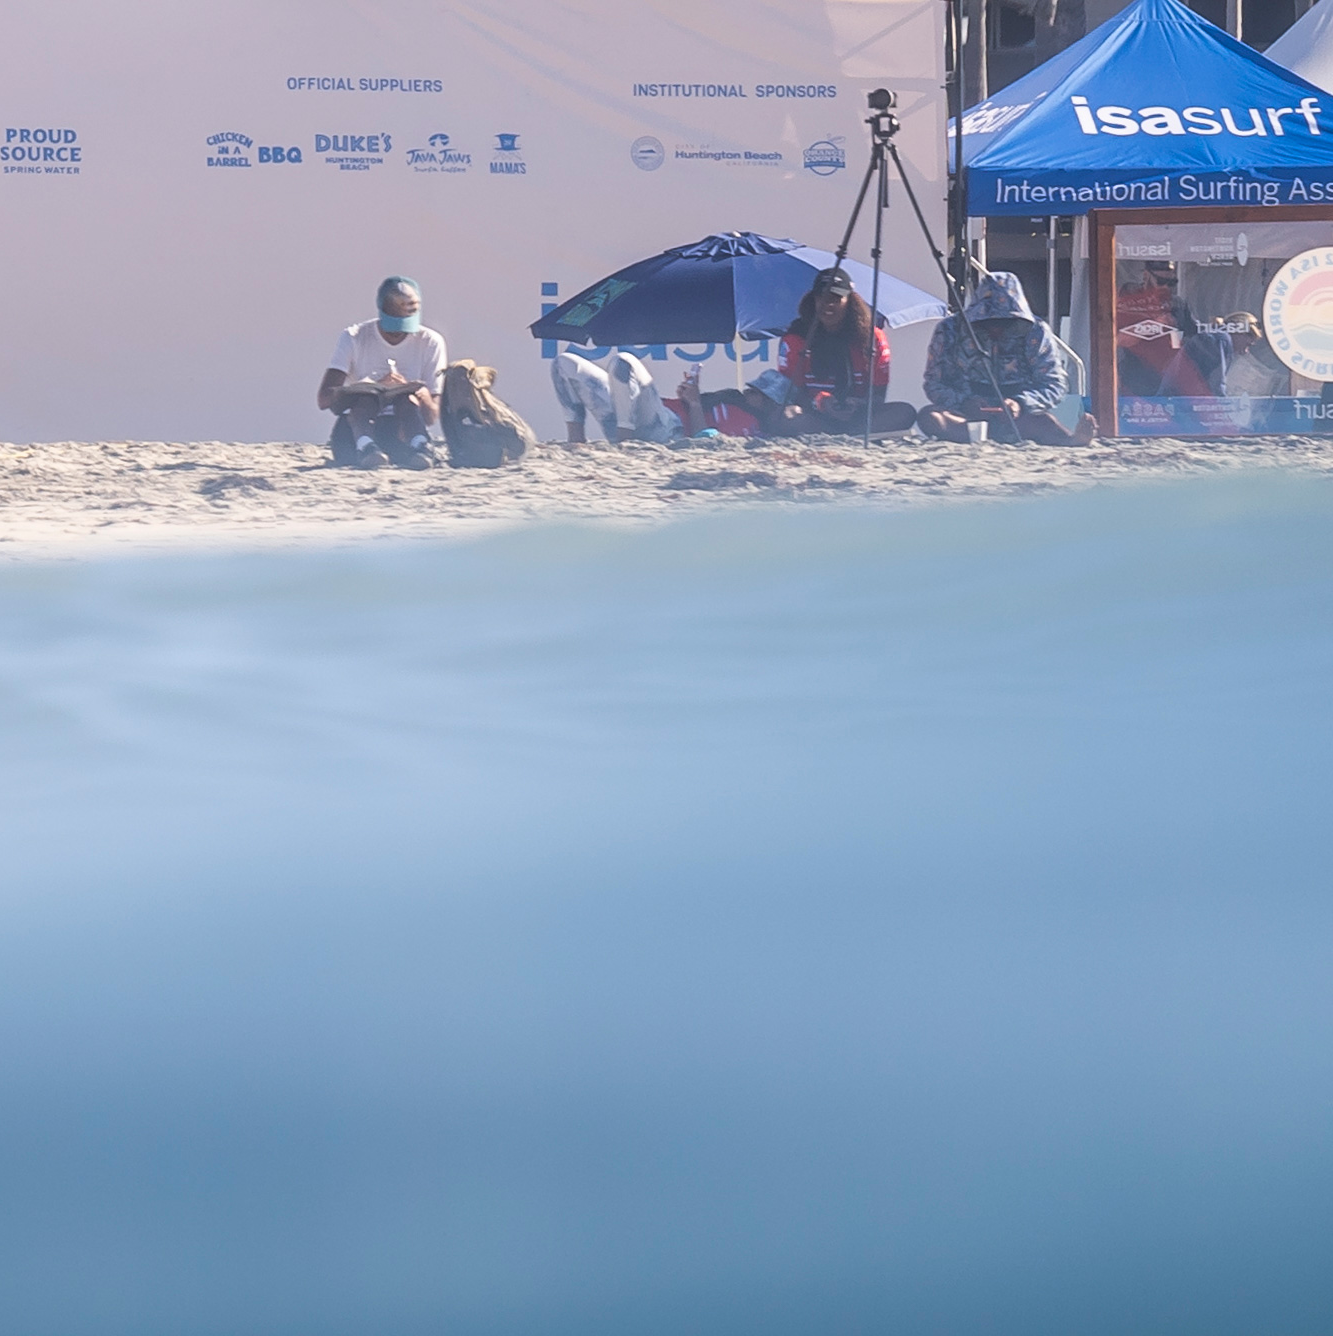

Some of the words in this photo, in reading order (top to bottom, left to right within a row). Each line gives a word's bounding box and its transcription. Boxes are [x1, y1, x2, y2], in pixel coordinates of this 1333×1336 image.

[286, 77, 355, 91] OFFICIAL
[359, 78, 443, 93] SUPPLIERS
[633, 83, 747, 98] INSTITUTIONAL
[755, 84, 837, 99] SPONSORS
[1070, 95, 1322, 137] isasurf
[5, 128, 77, 144] PROUD
[206, 131, 254, 149] CHICKEN
[314, 132, 392, 154] DUKE'S
[0, 146, 82, 163] SOURCE
[206, 156, 252, 168] BARREL
[258, 146, 303, 164] BBQ
[675, 150, 741, 162] Huntington
[744, 150, 783, 161] Beach
[3, 165, 42, 175] SPRING
[44, 166, 81, 175] WATER
[995, 176, 1170, 204] International
[1179, 174, 1280, 206] Surfing
